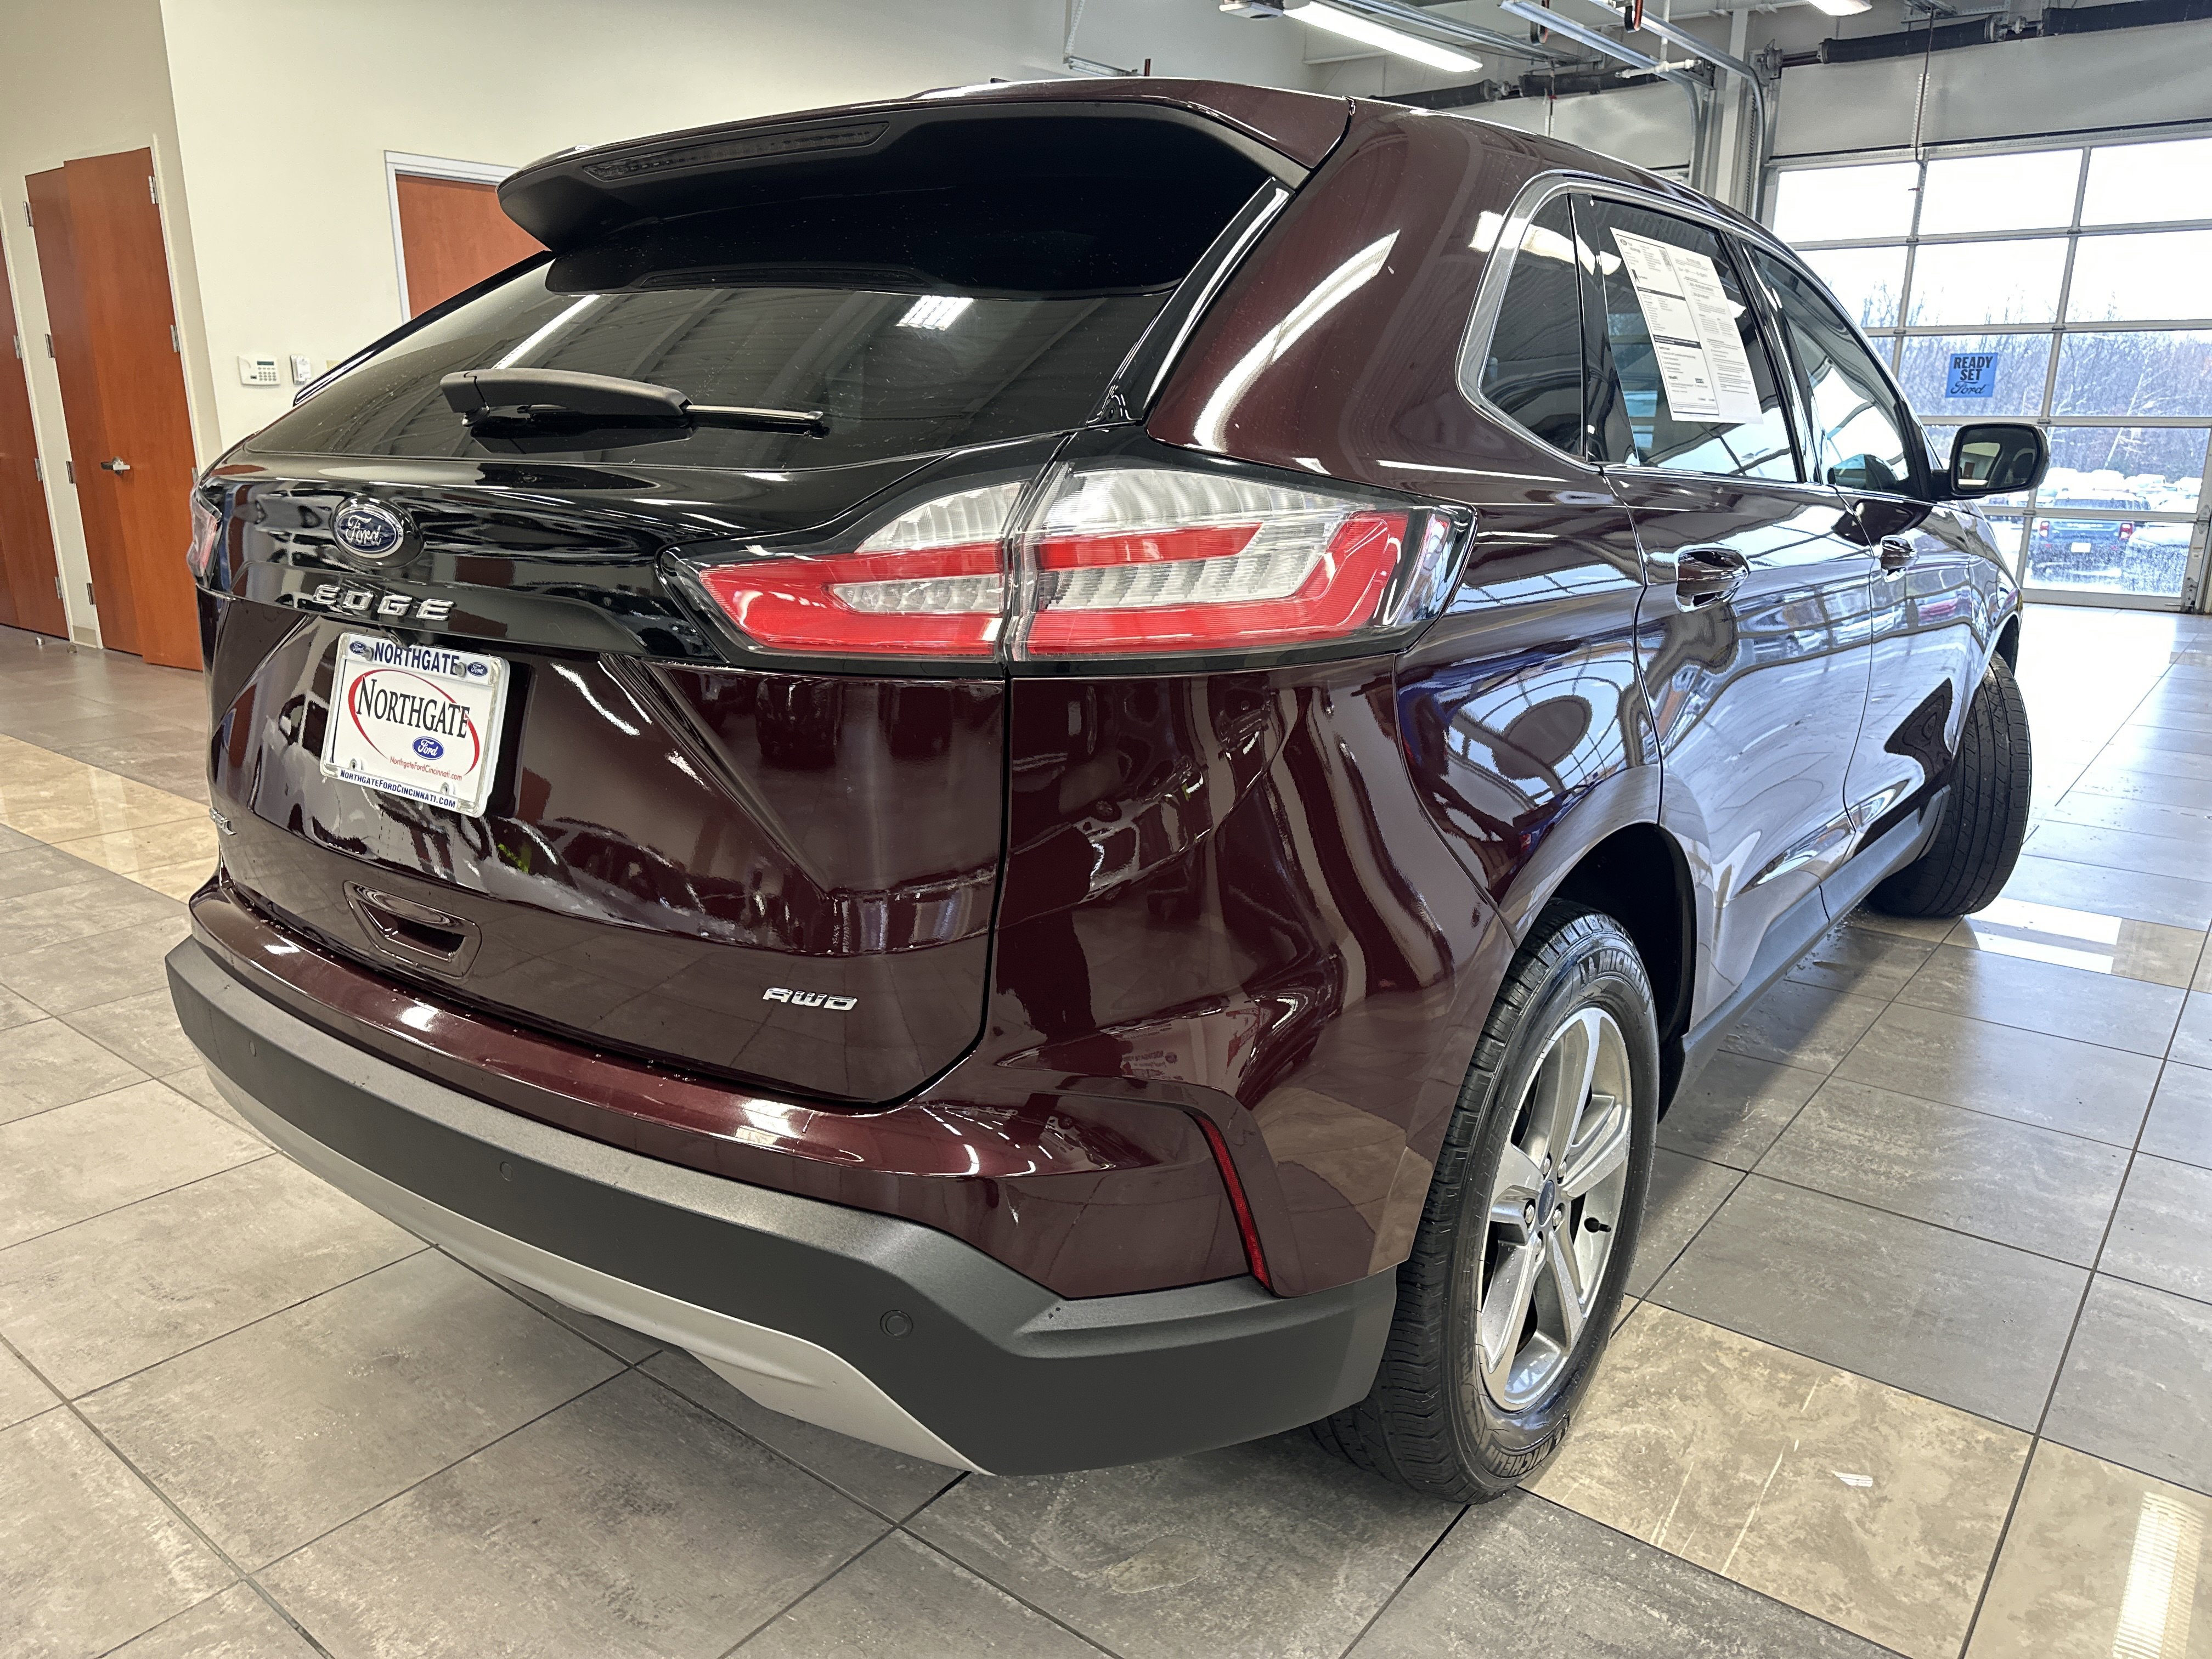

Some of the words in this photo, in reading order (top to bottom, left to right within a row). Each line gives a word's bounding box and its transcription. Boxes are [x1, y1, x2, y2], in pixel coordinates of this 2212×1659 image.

[1953, 356, 1993, 369] READY
[1960, 369, 1982, 381] SET
[1950, 380, 1987, 394] Ford
[345, 515, 382, 546] Ford
[312, 584, 455, 621] EDGE
[374, 642, 460, 675] NORTHGATE
[356, 675, 470, 739] NORTHGATE
[390, 756, 462, 782] NorthgateFordCincinnati.com
[1598, 949, 1651, 1004] MICHELIN
[763, 987, 858, 1011] AWD
[1485, 1435, 1553, 1477] MICHELIN
